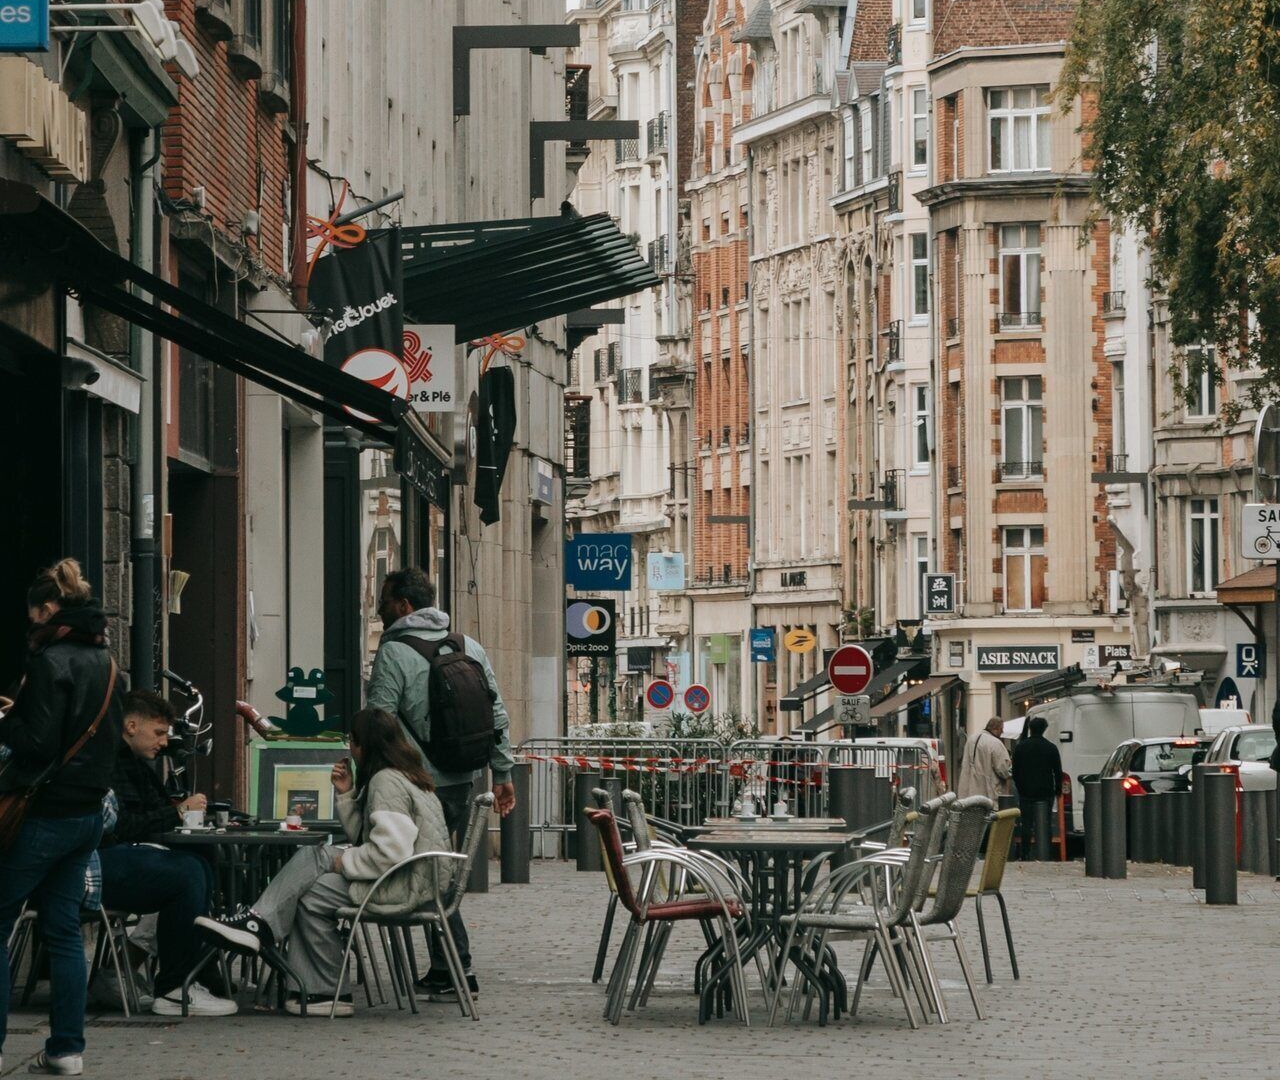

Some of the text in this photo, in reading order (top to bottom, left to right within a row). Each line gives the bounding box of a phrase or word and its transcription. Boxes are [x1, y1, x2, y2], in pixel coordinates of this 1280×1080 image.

[420, 390, 430, 402] &
[577, 544, 629, 558] mac
[577, 558, 628, 580] way
[588, 643, 609, 652] 2000
[1105, 645, 1128, 657] Plats
[979, 652, 1010, 665] ASIE
[1012, 651, 1057, 665] SNACK
[841, 698, 861, 706] SAUF
